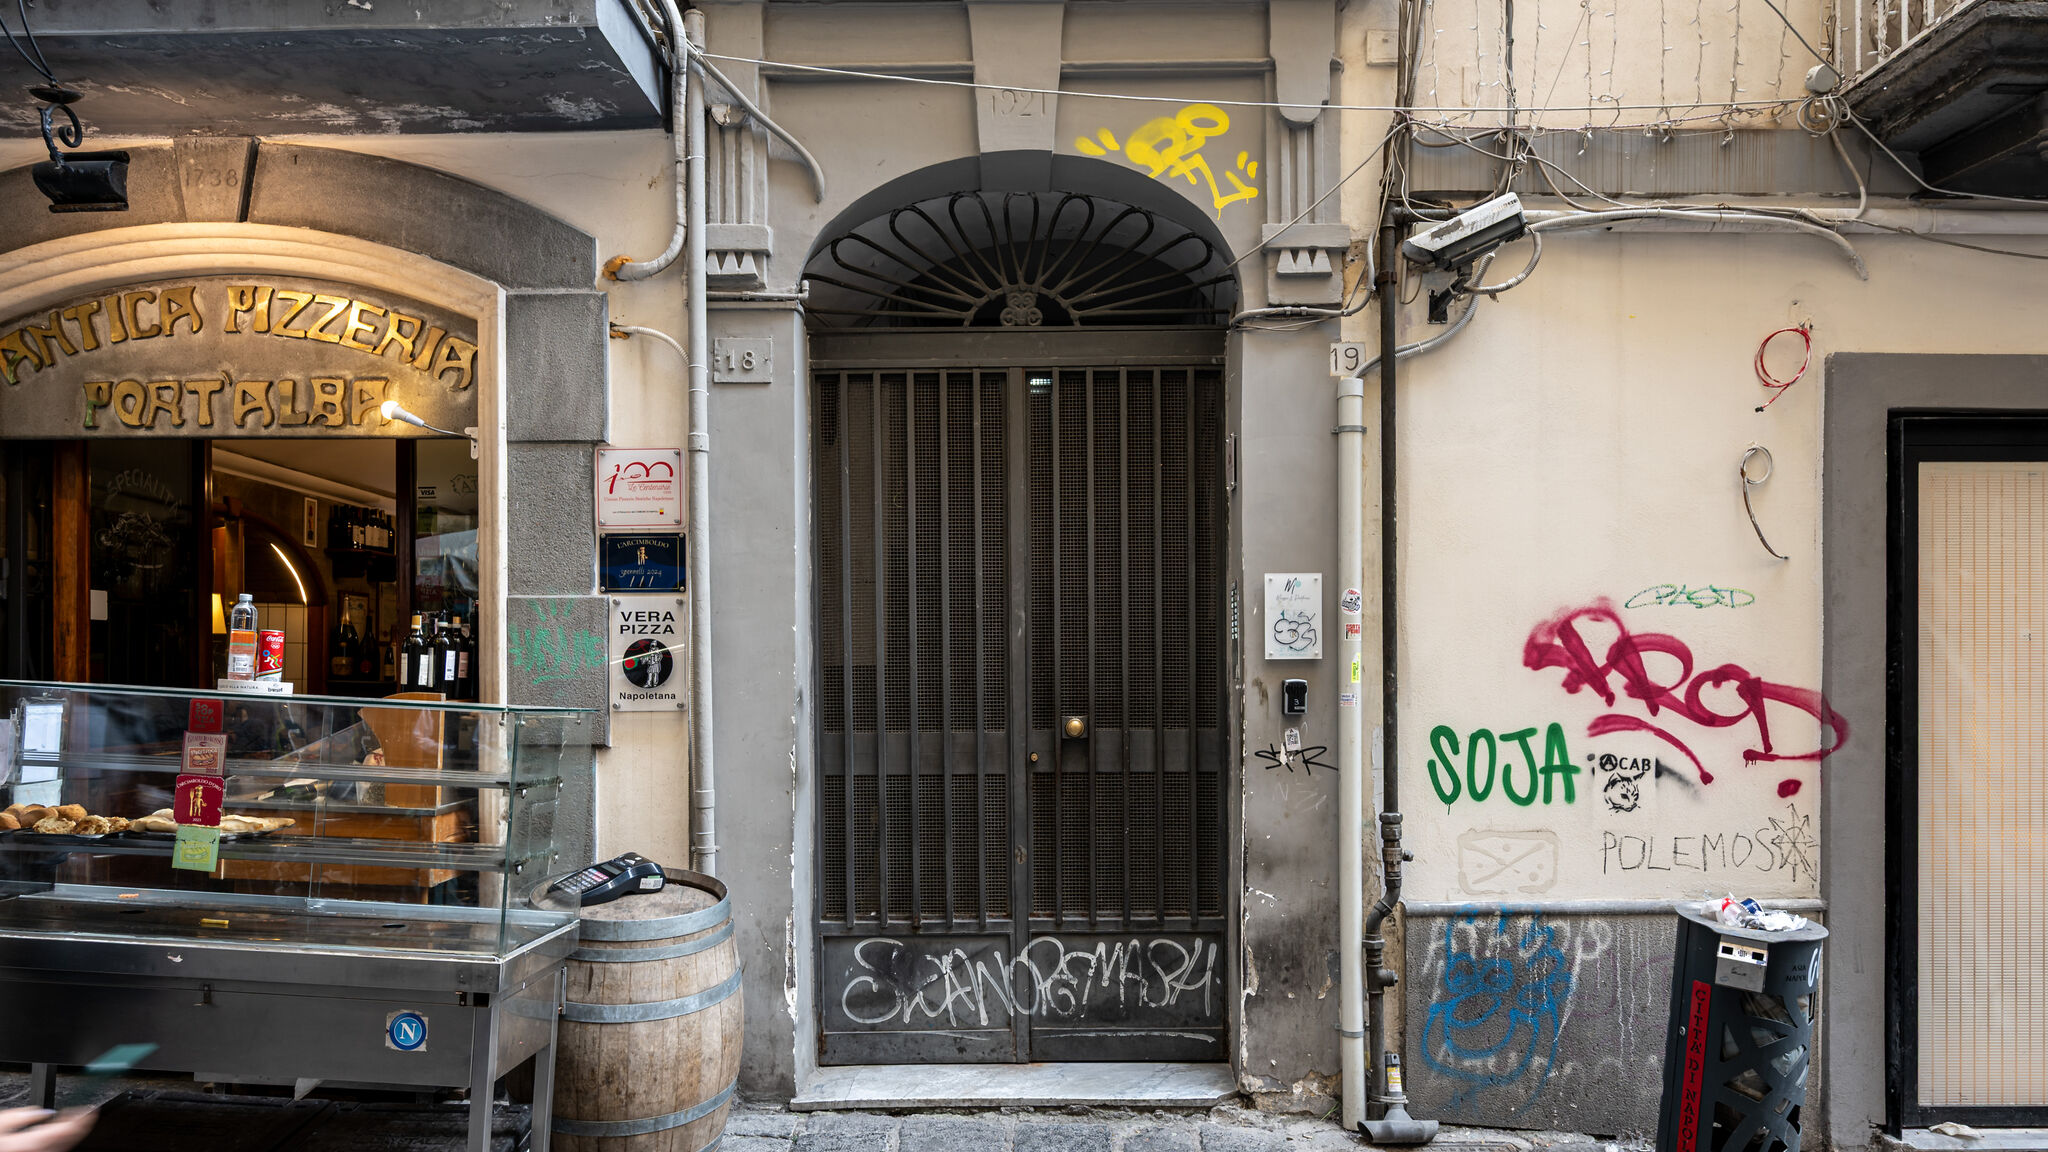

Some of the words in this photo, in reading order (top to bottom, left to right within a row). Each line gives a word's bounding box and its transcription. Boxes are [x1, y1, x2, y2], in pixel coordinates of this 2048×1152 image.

[991, 88, 1046, 117] 1921
[185, 168, 239, 188] 1738
[0, 285, 203, 386] ANTICA
[223, 285, 479, 391] PIZZERIA
[725, 350, 757, 371] 18
[1331, 346, 1360, 372] 19
[82, 371, 395, 429] PORT'ALBA
[420, 488, 436, 497] VISA
[617, 539, 670, 549] L'ARCIMBOLDO
[620, 611, 675, 622] VERA
[620, 624, 675, 635] PIZZA
[619, 692, 677, 701] Napoletana
[1427, 721, 1582, 812] SOJA
[1599, 753, 1652, 772] ACAB
[1600, 827, 1775, 875] POLEMOS
